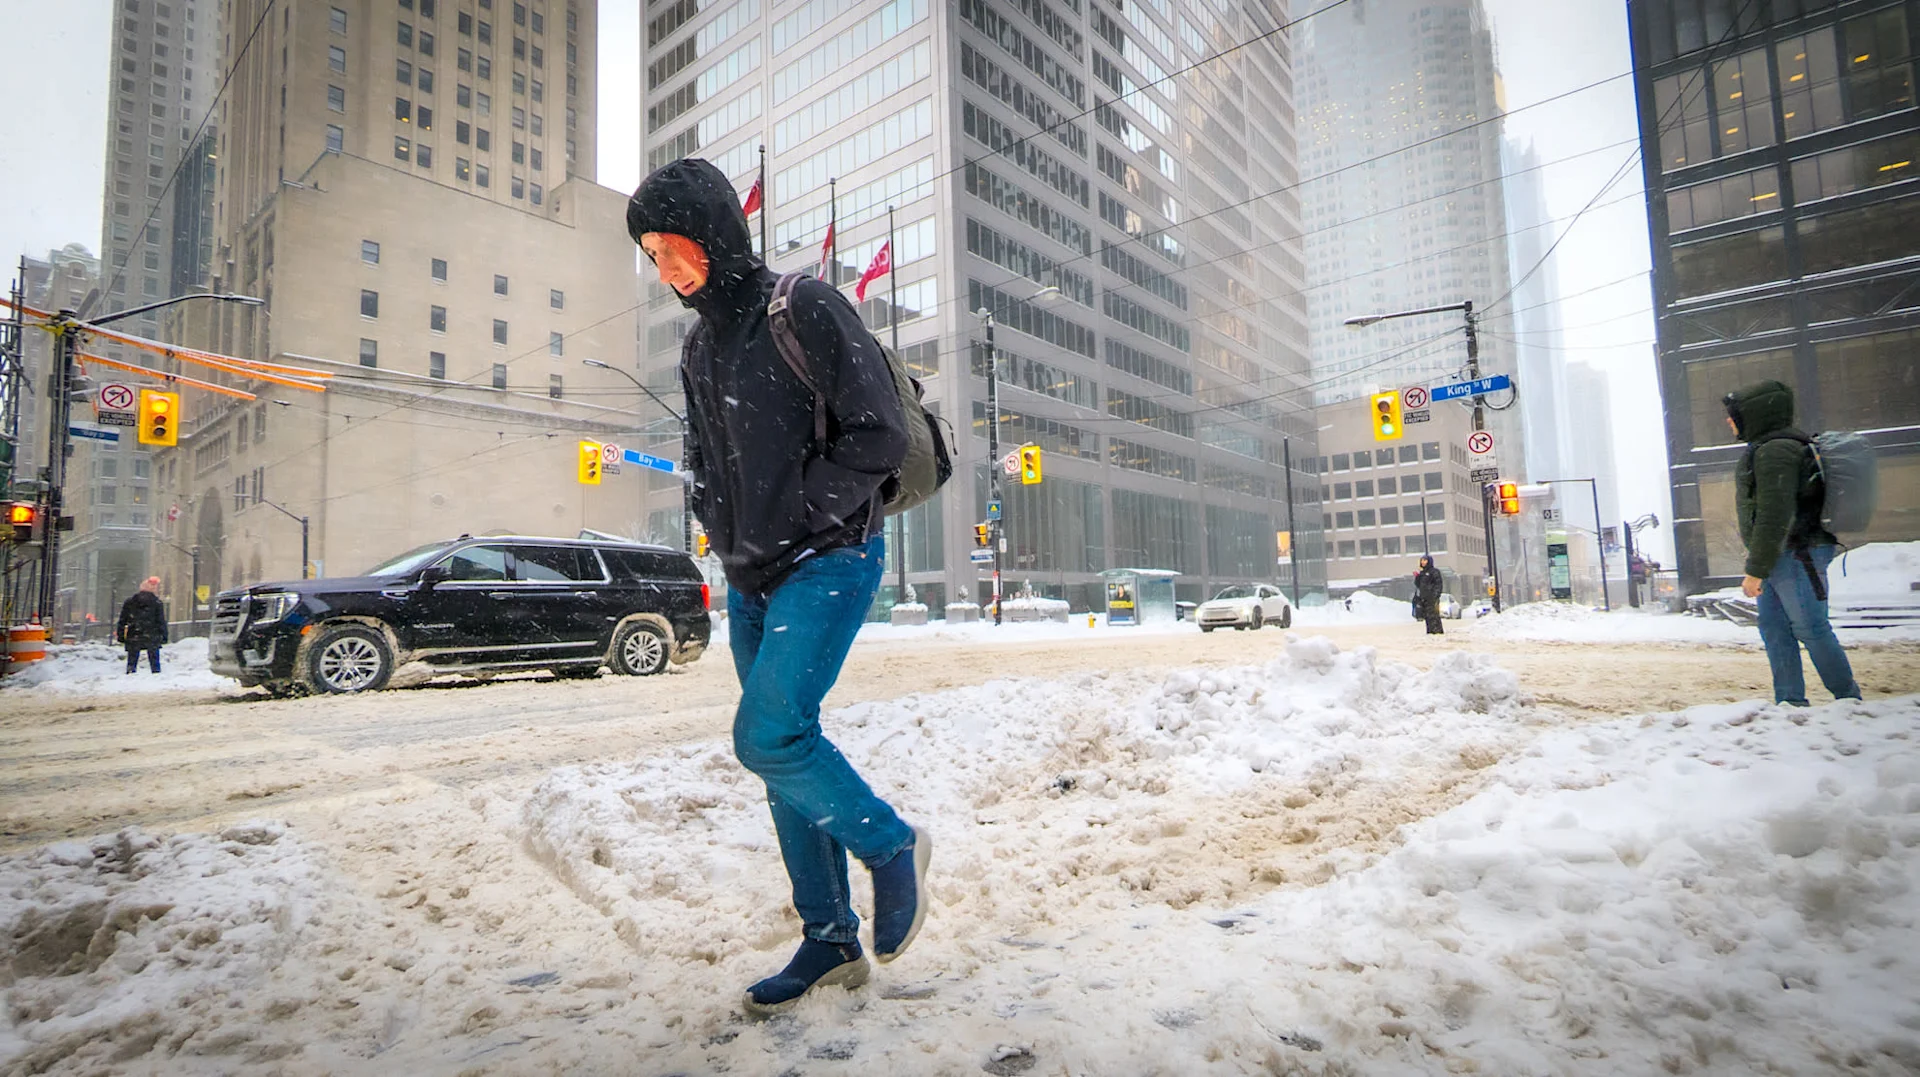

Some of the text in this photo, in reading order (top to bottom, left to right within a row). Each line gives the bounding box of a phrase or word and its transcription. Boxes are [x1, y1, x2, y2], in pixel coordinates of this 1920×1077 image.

[1446, 383, 1471, 397] King
[1481, 379, 1492, 389] W
[99, 418, 135, 426] EXCEPTED
[638, 453, 654, 466] Bay
